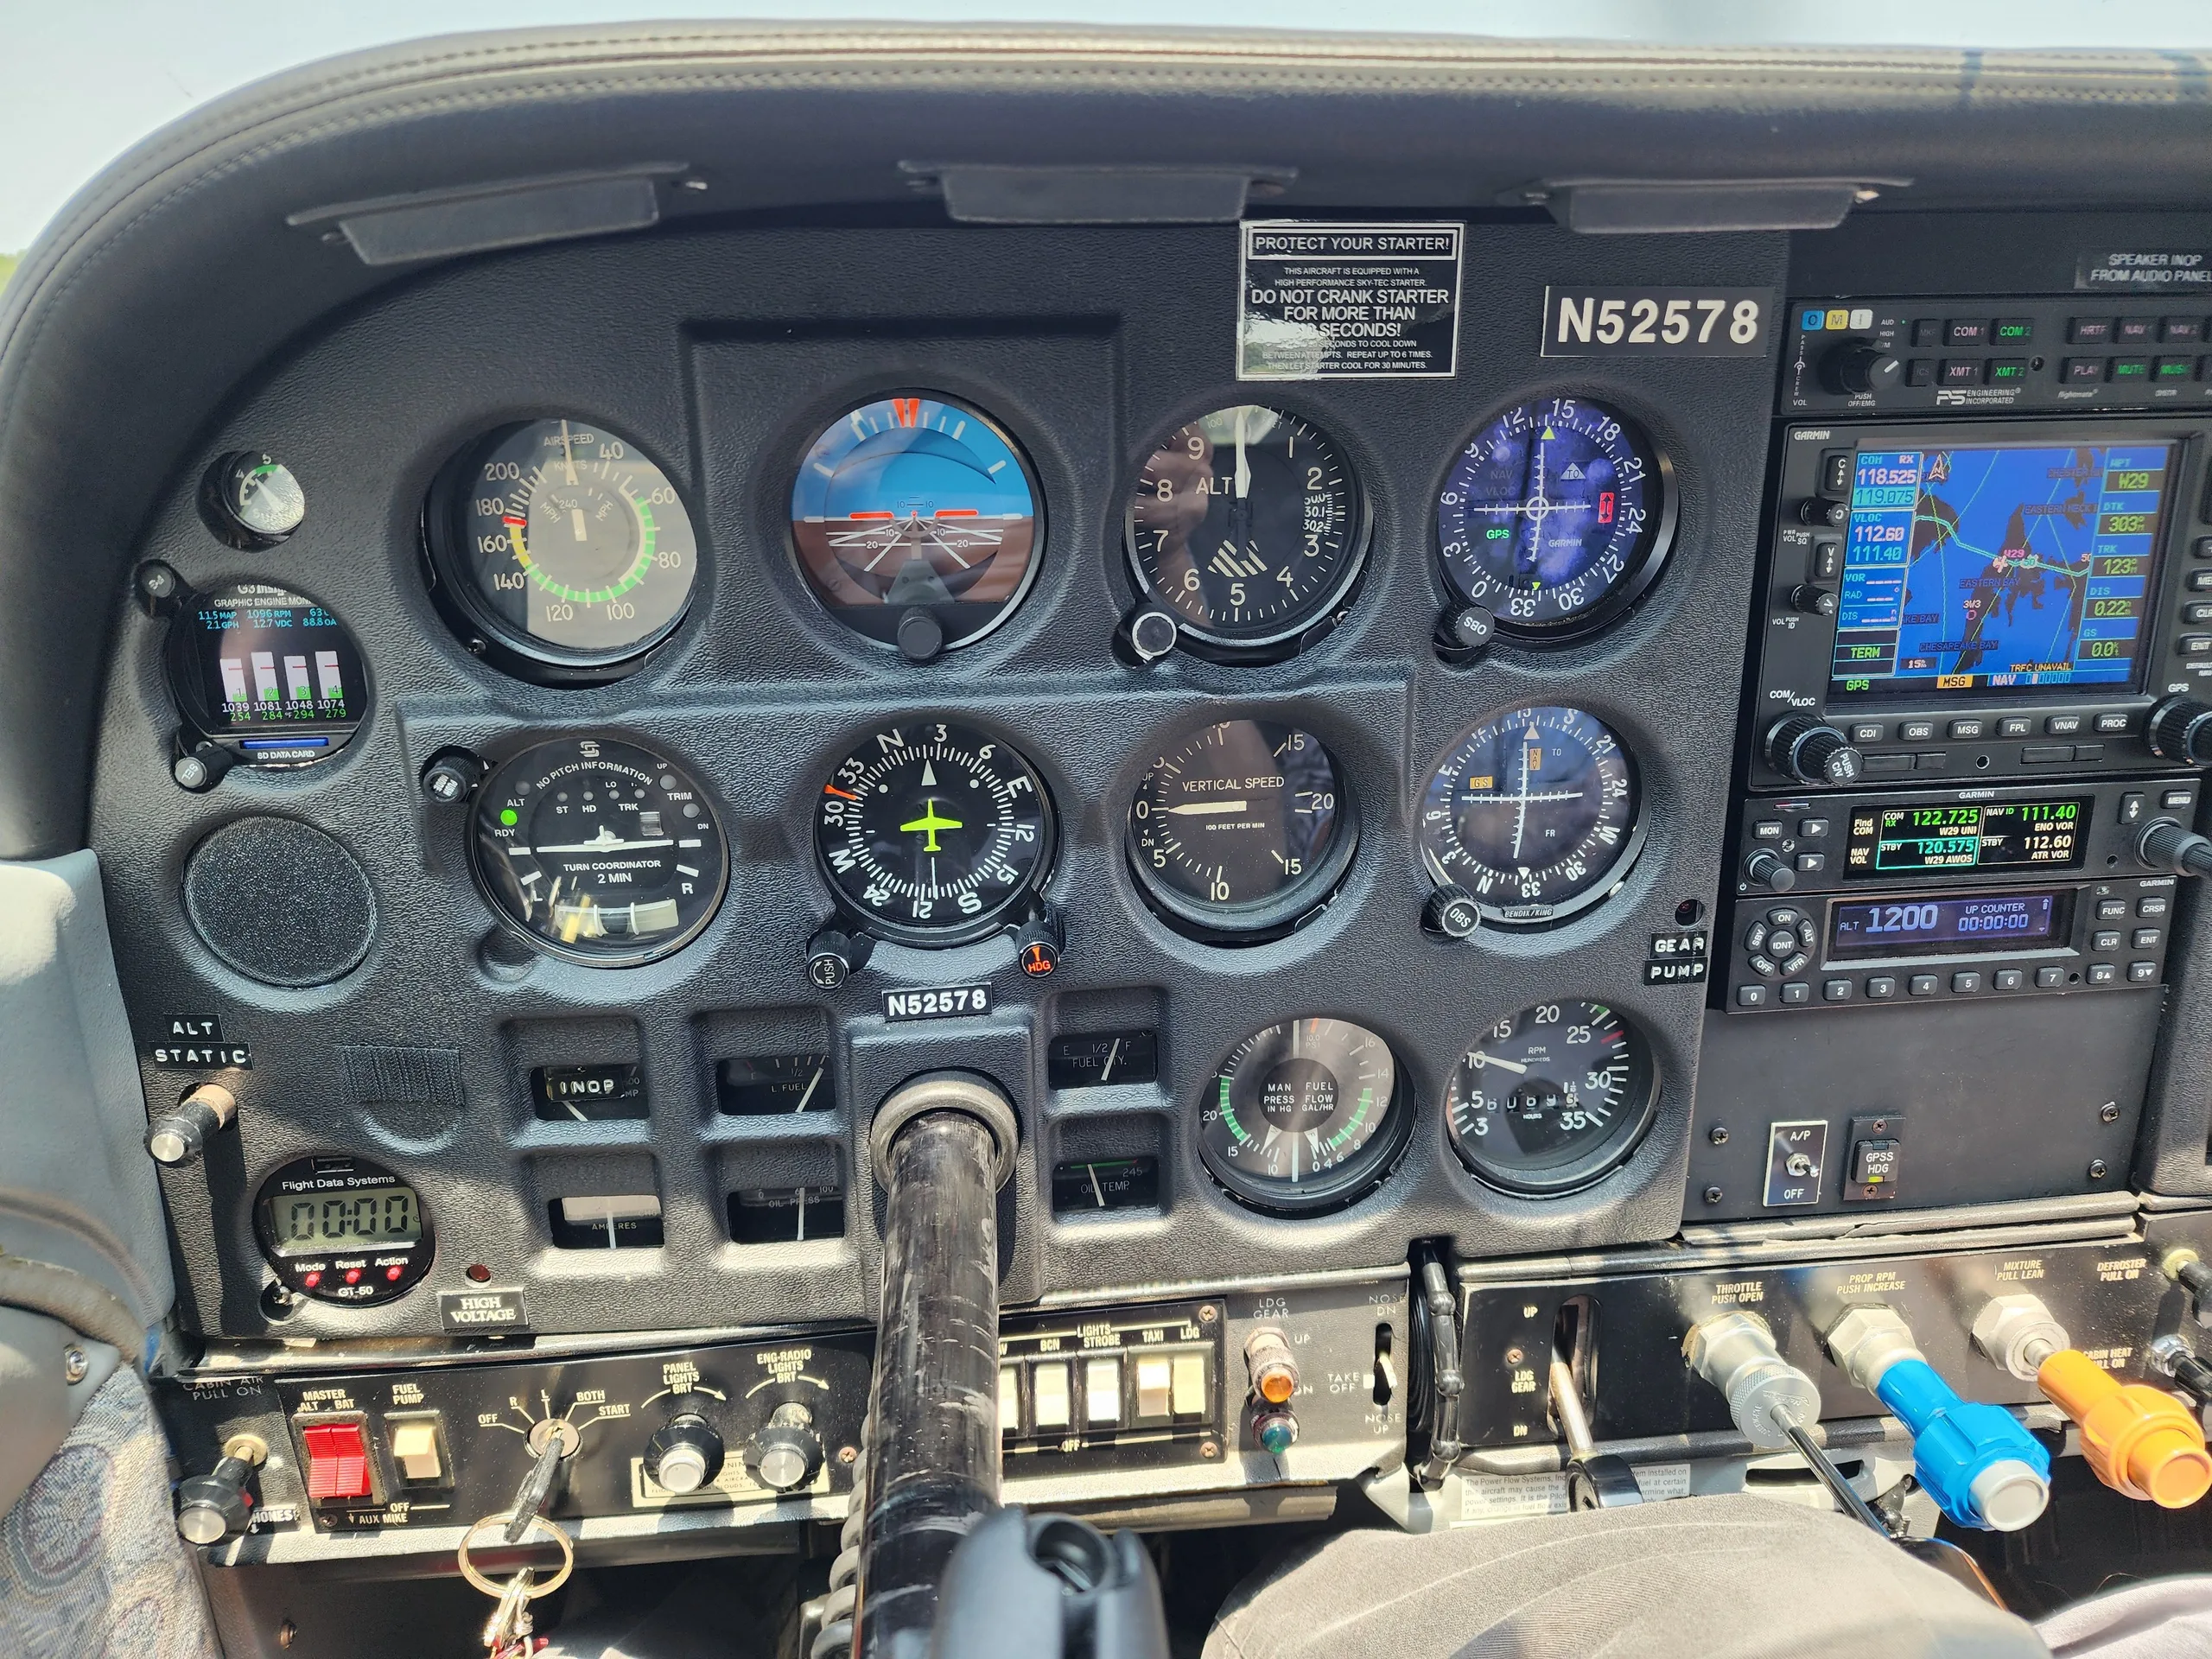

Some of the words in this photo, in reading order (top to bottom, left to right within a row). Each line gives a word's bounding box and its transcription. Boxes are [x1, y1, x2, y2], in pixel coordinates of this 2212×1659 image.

[1255, 237, 1326, 251] PROTECT
[1330, 237, 1374, 250] YOUR
[1377, 237, 1449, 250] STARTER!
[1251, 289, 1276, 304] DO
[1280, 289, 1314, 304] NOT
[1317, 289, 1374, 304] CRANK
[1376, 289, 1449, 303] STARTER
[1284, 307, 1319, 321] FOR
[1322, 306, 1370, 321] MORE
[1375, 306, 1415, 321] THAN
[1557, 297, 1758, 345] N52578
[1319, 323, 1401, 337] SECONDS!
[1794, 431, 1830, 441] GARMIN
[484, 462, 519, 481] 200
[1858, 468, 1916, 485] 118.525
[1195, 477, 1233, 495] ALT
[1857, 490, 1914, 504] 119.075
[476, 497, 504, 517] 180
[1486, 529, 1510, 539] GPS
[1855, 525, 1904, 543] 112.60
[478, 535, 507, 554] 160
[1548, 538, 1582, 548] GARMIN
[1853, 545, 1901, 562] 111.40
[493, 572, 524, 591] 140
[214, 598, 253, 607] GRAPHIC
[254, 597, 288, 606] ENGINE
[546, 604, 573, 622] 120
[607, 602, 635, 621] 100
[1851, 647, 1880, 658] TERM
[2010, 664, 2032, 672] TRFC
[2035, 662, 2071, 671] UNAVAIL
[1846, 680, 1869, 691] GPS
[1943, 677, 1966, 687] MSG
[221, 702, 250, 712] 1039
[253, 702, 282, 711] 1081
[285, 701, 314, 710] 1048
[317, 700, 345, 709] 1074
[230, 711, 251, 721] 254
[262, 710, 283, 720] 284
[2009, 722, 2026, 733] FPL
[2054, 721, 2078, 731] VNAV
[2101, 719, 2127, 728] PROC
[1859, 728, 1877, 739] CDI
[1908, 726, 1929, 737] OBS
[1956, 725, 1979, 735] MSG
[1182, 779, 1242, 792] VERTICAL
[1244, 776, 1285, 788] SPEED
[667, 791, 692, 801] TRIM
[1958, 791, 1994, 799] GARMIN
[2167, 796, 2191, 804] MENU
[506, 798, 525, 807] ALT
[582, 804, 597, 813] HD
[618, 803, 639, 812] TRK
[556, 805, 569, 814] ST
[1884, 812, 1904, 821] COM
[1913, 809, 1979, 827] 122.725
[1939, 827, 1958, 836] W29
[1961, 826, 1977, 835] UNI
[2034, 823, 2053, 831] ENO
[2056, 822, 2074, 830] VOR
[494, 829, 515, 837] RDY
[1141, 838, 1154, 847] DN
[1880, 842, 1902, 851] STBY
[1917, 840, 1974, 855] 120.575
[1981, 838, 2004, 847] STBY
[2024, 835, 2071, 849] 112.60
[1924, 855, 1943, 865] W29
[1945, 855, 1973, 863] AWOS
[2031, 851, 2049, 860] ATR
[2051, 850, 2069, 859] VOR
[563, 863, 590, 872] TURN
[592, 860, 662, 871] COORDINATOR
[597, 874, 607, 884] 2
[608, 873, 632, 883] MIN
[2139, 879, 2174, 887] GARMIN
[2142, 905, 2165, 913] CRSR
[1865, 905, 1938, 934] 1200
[1958, 913, 2028, 931] 00:00:00
[1840, 922, 1859, 931] ALT
[1654, 938, 1705, 953] GEAR
[1772, 941, 1793, 950] IDNT
[2140, 936, 2158, 944] ENT
[1027, 960, 1051, 973] HDG
[1650, 963, 1704, 979] PUMP
[887, 989, 987, 1017] N52578
[173, 1020, 213, 1036] ALT
[155, 1048, 247, 1065] STATIC
[1528, 1046, 1546, 1055] RPM
[1268, 1082, 1292, 1092] MAN
[1306, 1082, 1333, 1090] FUEL
[1263, 1095, 1295, 1104] PRESS
[1305, 1094, 1333, 1103] FLOW
[1279, 1104, 1292, 1113] HG
[1301, 1103, 1334, 1112] GAL/HR
[1866, 1152, 1894, 1162] GPSS
[1867, 1164, 1889, 1174] HDG
[282, 1177, 315, 1191] Flight
[316, 1175, 345, 1188] Data
[346, 1174, 396, 1187] Systems
[1783, 1188, 1804, 1199] OFF
[335, 1258, 365, 1270] Reset
[374, 1255, 409, 1267] Action
[2003, 1259, 2043, 1272] MIXTURE
[295, 1262, 326, 1273] Mode
[1849, 1274, 1873, 1285] PROP
[1875, 1271, 1896, 1283] RPM
[1715, 1281, 1764, 1295] THROTTLE
[1836, 1283, 1859, 1296] PUSH
[1859, 1280, 1906, 1294] INCREASE
[461, 1297, 501, 1310] HIGH
[1258, 1297, 1287, 1309] LDG
[1711, 1294, 1736, 1306] PUSH
[1738, 1291, 1764, 1303] OPEN
[449, 1306, 516, 1323] VOLTAGE
[1253, 1307, 1289, 1320] GEAR
[1523, 1305, 1538, 1319] UP
[1084, 1333, 1120, 1348] STROBE
[1142, 1328, 1164, 1343] TAXI
[1294, 1333, 1311, 1345] UP
[1040, 1339, 1060, 1351] BCN
[756, 1349, 812, 1366] ENG-RADIO
[663, 1362, 696, 1375] PANEL
[663, 1371, 700, 1385] LIGHTS
[1326, 1371, 1360, 1383] TAKE
[392, 1383, 421, 1395] FUEL
[1328, 1382, 1356, 1395] OFF
[302, 1389, 346, 1401] MASTER
[392, 1393, 424, 1405] PUMP
[576, 1390, 606, 1402] BOTH
[599, 1403, 630, 1415] START
[478, 1414, 499, 1424] OFF
[1662, 1478, 1687, 1486] certain
[1481, 1485, 1505, 1495] aircraft
[390, 1502, 410, 1513] OFF
[359, 1514, 380, 1525] AUX
[383, 1512, 408, 1523] MIKE
